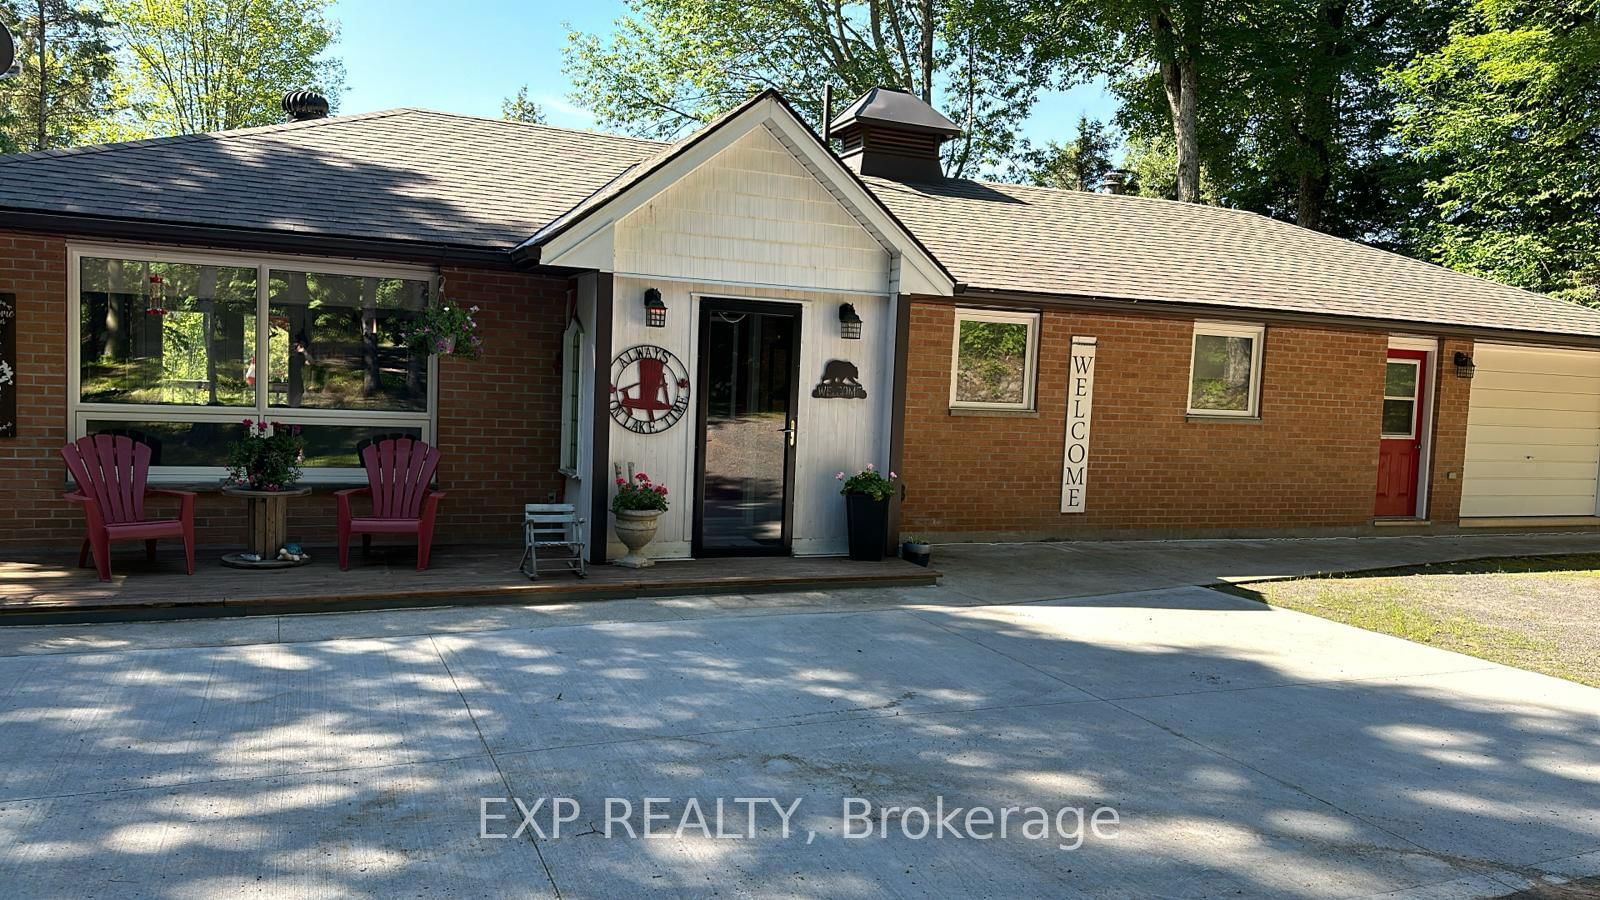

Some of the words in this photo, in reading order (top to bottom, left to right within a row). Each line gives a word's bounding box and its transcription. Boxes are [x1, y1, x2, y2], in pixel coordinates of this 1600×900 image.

[619, 347, 671, 368] ALWAYS
[609, 400, 622, 418] ON
[624, 415, 658, 433] LAKE
[661, 395, 689, 427] TIME
[1066, 356, 1094, 507] WELCOME
